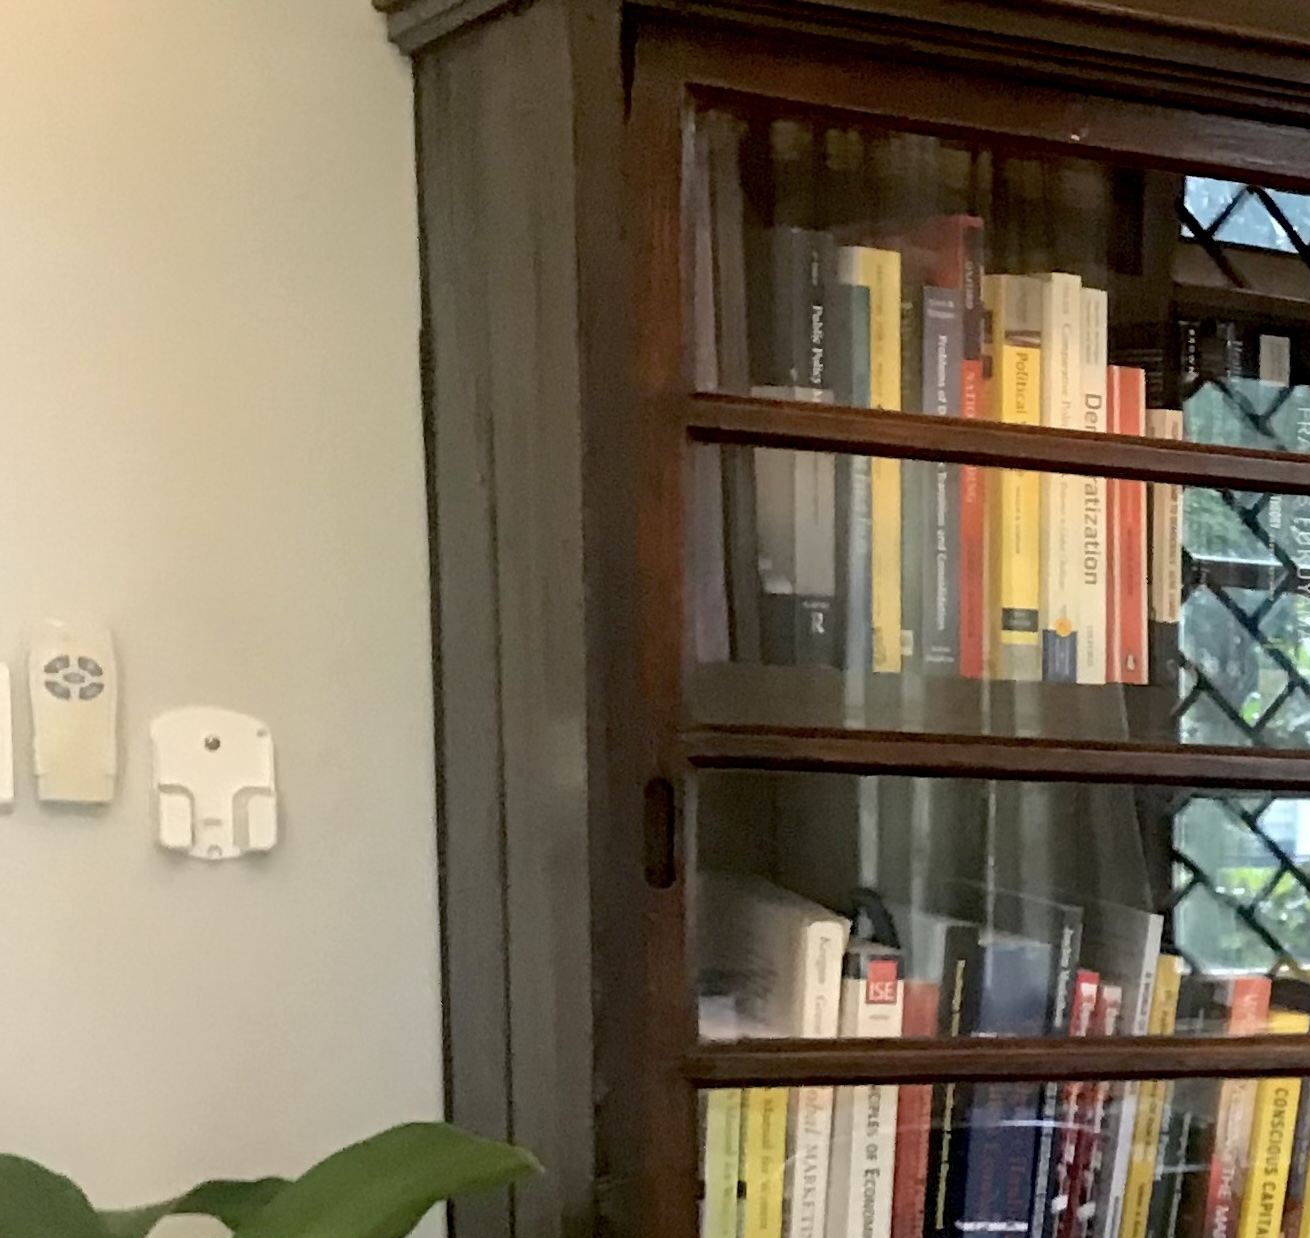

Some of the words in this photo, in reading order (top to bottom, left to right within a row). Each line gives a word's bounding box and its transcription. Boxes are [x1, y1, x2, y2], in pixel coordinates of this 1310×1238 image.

[810, 305, 824, 344] Public
[965, 372, 978, 419] NATIO
[1014, 351, 1030, 414] Political
[868, 980, 896, 1001] ISE
[863, 1143, 879, 1161] OF
[1264, 1087, 1290, 1176] CONSCIOUS
